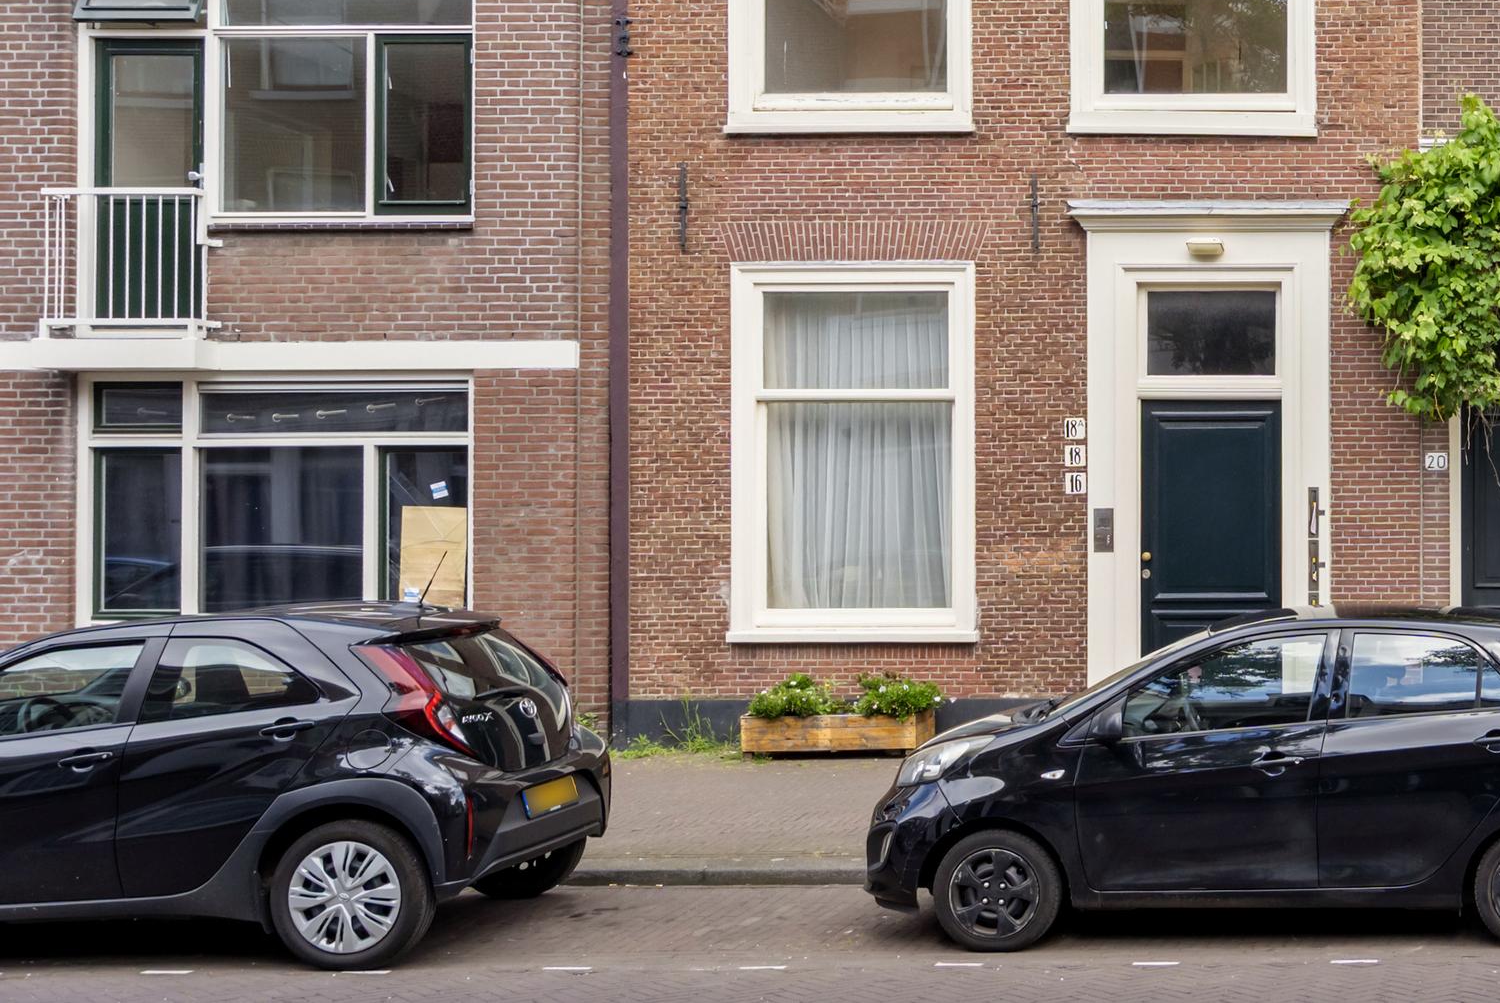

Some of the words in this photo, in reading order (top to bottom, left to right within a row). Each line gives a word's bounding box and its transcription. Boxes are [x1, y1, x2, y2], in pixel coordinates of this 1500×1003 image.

[1069, 447, 1081, 465] 18
[1427, 455, 1446, 469] 20
[1070, 474, 1082, 493] 16
